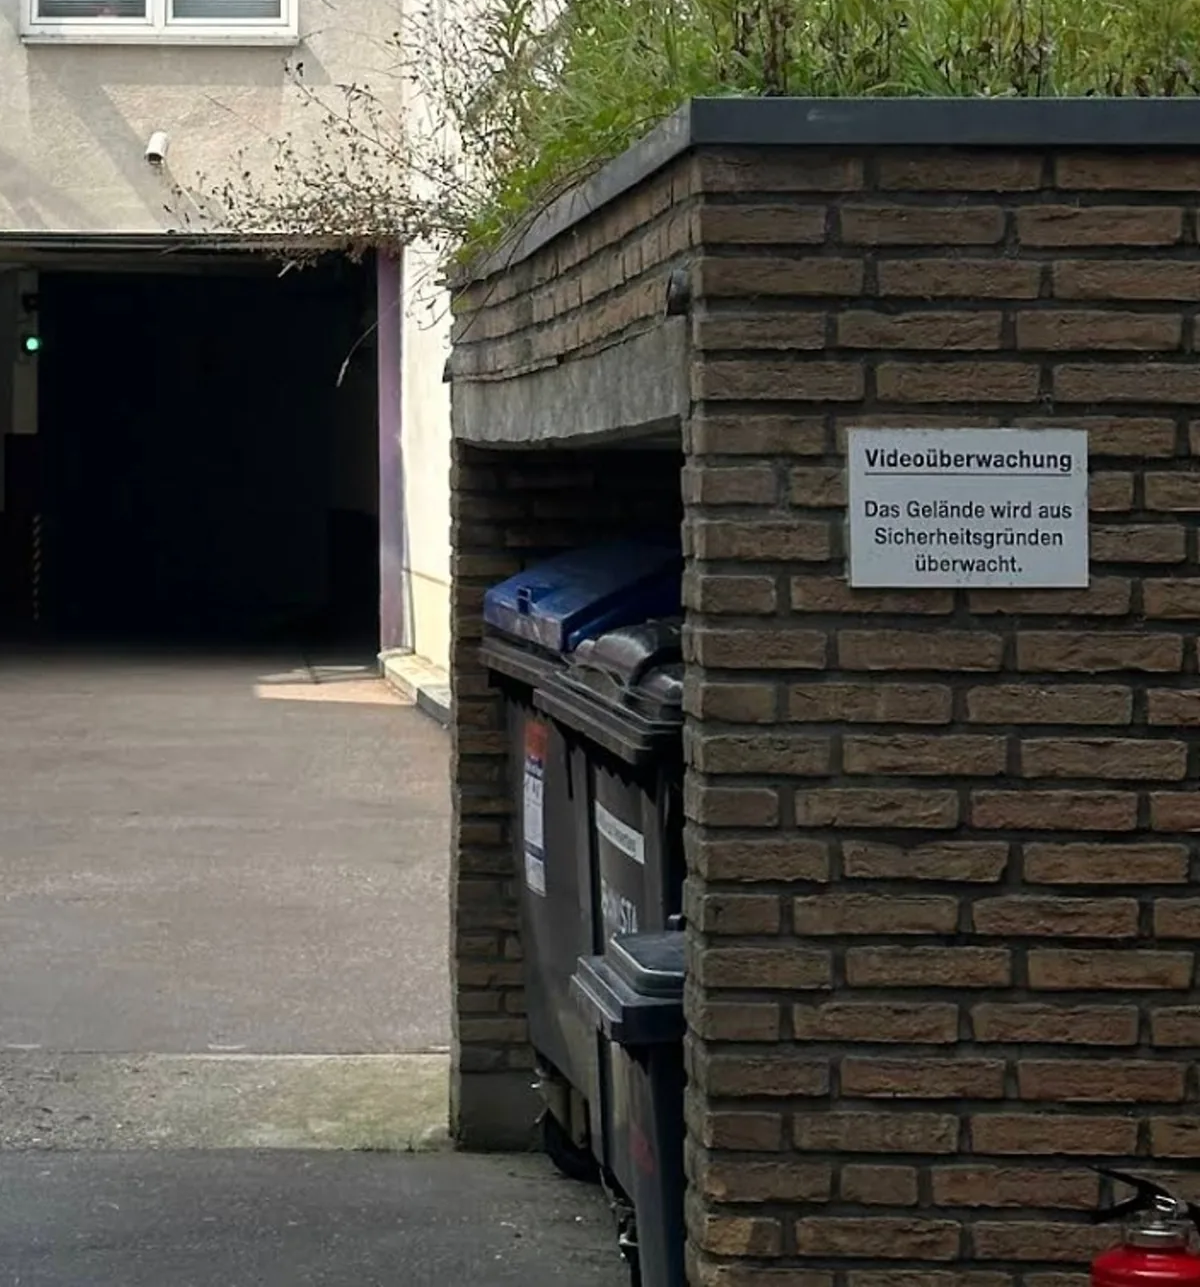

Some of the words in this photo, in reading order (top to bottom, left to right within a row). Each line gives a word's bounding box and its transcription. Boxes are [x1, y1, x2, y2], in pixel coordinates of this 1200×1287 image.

[865, 448, 1072, 472] Videoüberwachung
[865, 501, 900, 518] Das
[907, 500, 985, 518] Gelände
[990, 501, 1032, 518] wird
[1038, 505, 1073, 518] aus
[874, 527, 1063, 549] Sicherheitsgründen
[915, 555, 1023, 573] überwacht.
